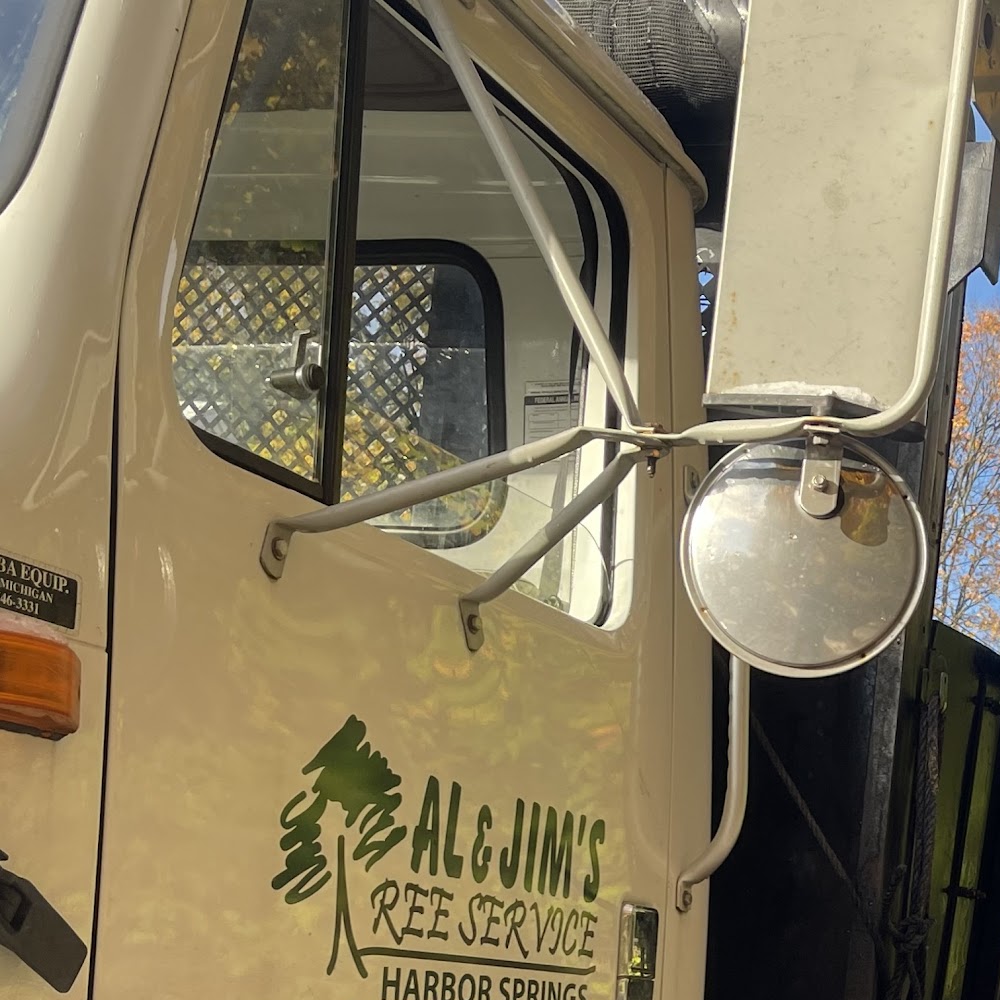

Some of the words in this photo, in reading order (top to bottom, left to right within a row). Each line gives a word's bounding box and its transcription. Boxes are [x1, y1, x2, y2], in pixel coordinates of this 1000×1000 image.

[0, 577, 54, 604] MICHIGAN
[20, 562, 70, 594] EQUIP.
[410, 775, 463, 879] AL
[471, 804, 492, 884] &
[499, 797, 605, 903] JIM'S
[458, 892, 598, 959] SERVICE
